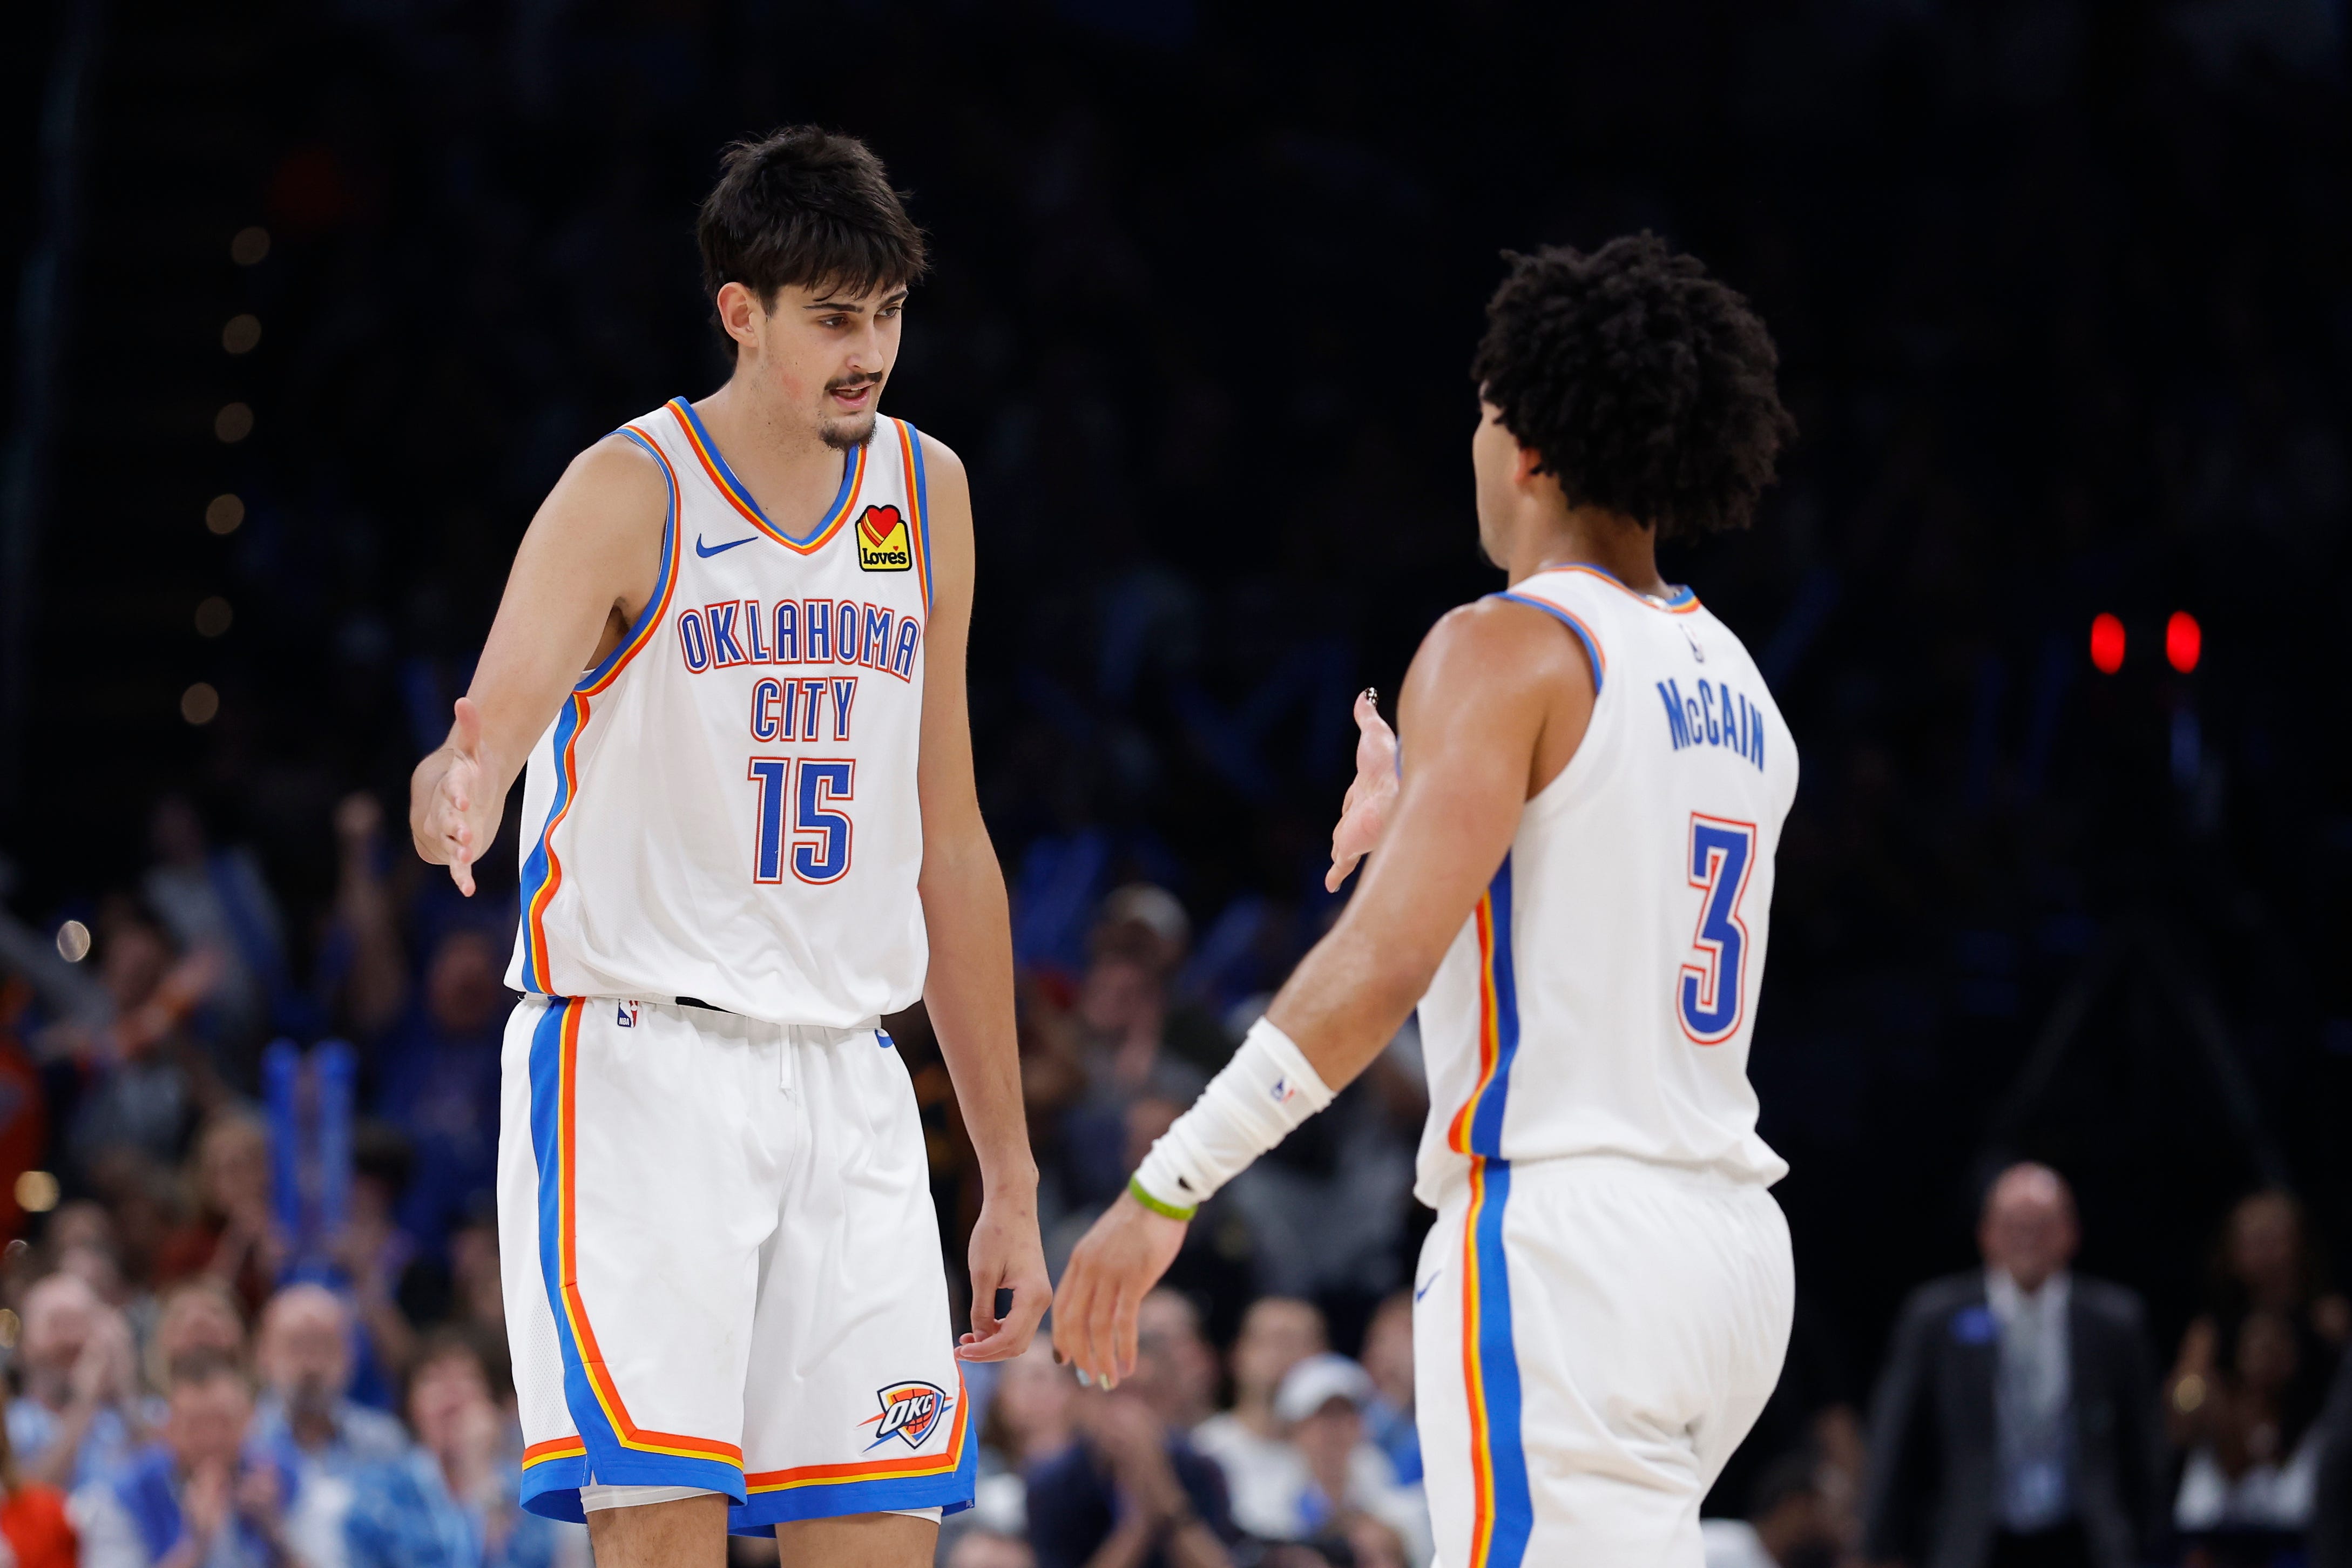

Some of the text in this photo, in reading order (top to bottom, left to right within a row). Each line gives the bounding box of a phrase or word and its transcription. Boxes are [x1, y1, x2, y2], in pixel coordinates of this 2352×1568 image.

[677, 598, 920, 684] OKLAHOMA
[751, 677, 859, 742] CITY
[1656, 678, 1764, 772] McCAIN
[747, 756, 856, 886] 15
[1676, 810, 1756, 1046] 3
[877, 1393, 934, 1436] OKC
